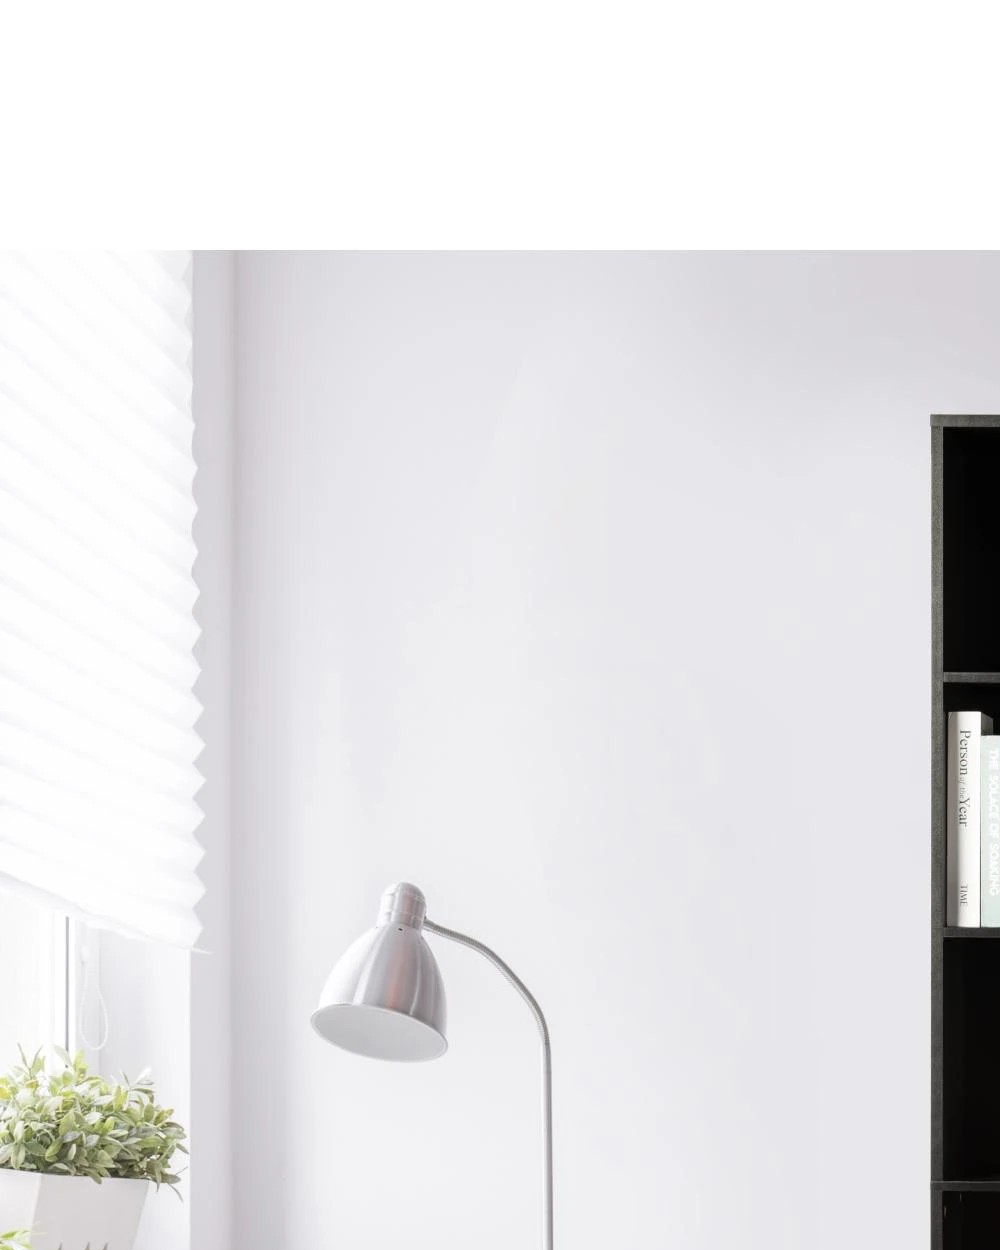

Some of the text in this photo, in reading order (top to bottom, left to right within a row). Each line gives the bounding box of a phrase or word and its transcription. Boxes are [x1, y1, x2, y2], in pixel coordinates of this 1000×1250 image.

[960, 730, 972, 776] Person
[958, 798, 971, 828] Year
[988, 748, 999, 897] THE SOLACE OF SOAKING
[960, 884, 968, 905] TIME
